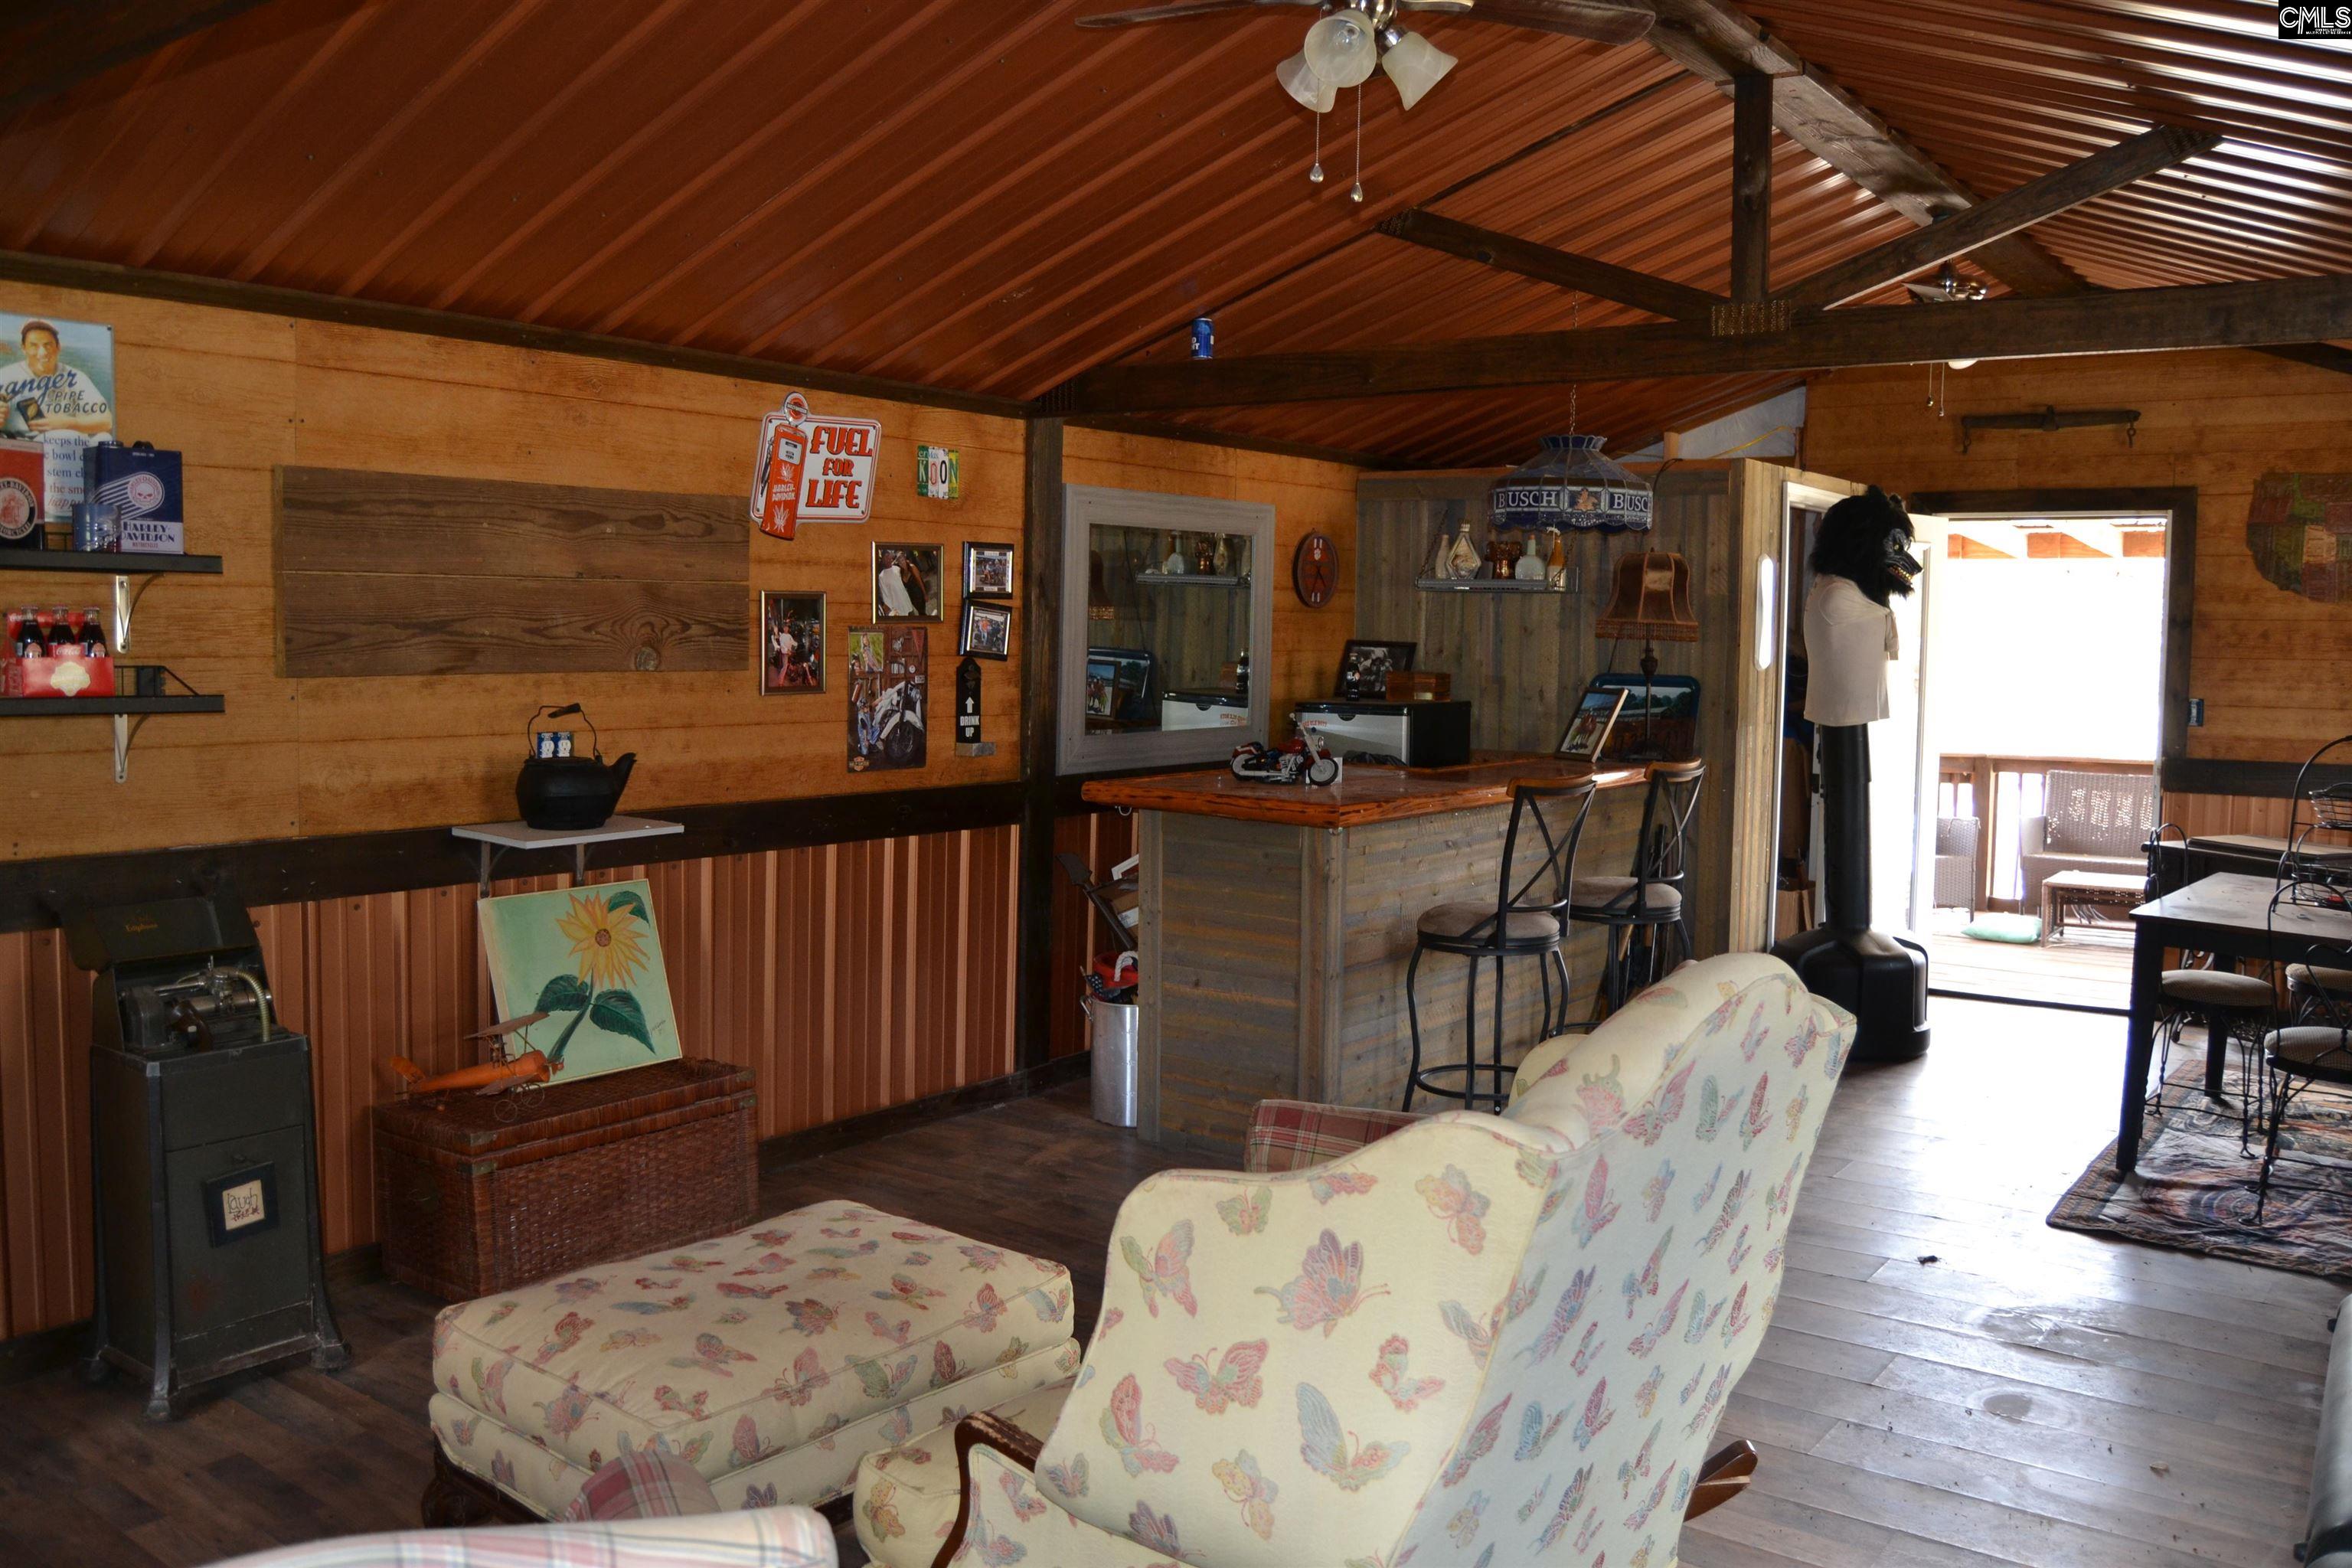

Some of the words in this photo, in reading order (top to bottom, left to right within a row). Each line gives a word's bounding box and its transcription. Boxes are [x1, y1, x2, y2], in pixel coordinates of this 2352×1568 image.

[0, 369, 78, 407] anger
[55, 390, 86, 401] PIPE
[46, 402, 108, 414] TOBACCO
[810, 426, 873, 456] FUEL
[52, 448, 77, 461] bowl
[47, 467, 72, 479] stem
[822, 457, 854, 477] FOR
[805, 478, 863, 509] LIFE
[1498, 491, 1558, 508] BUSCH
[1613, 493, 1651, 512] BUSC
[960, 716, 979, 726] DRINK
[965, 727, 974, 737] UP
